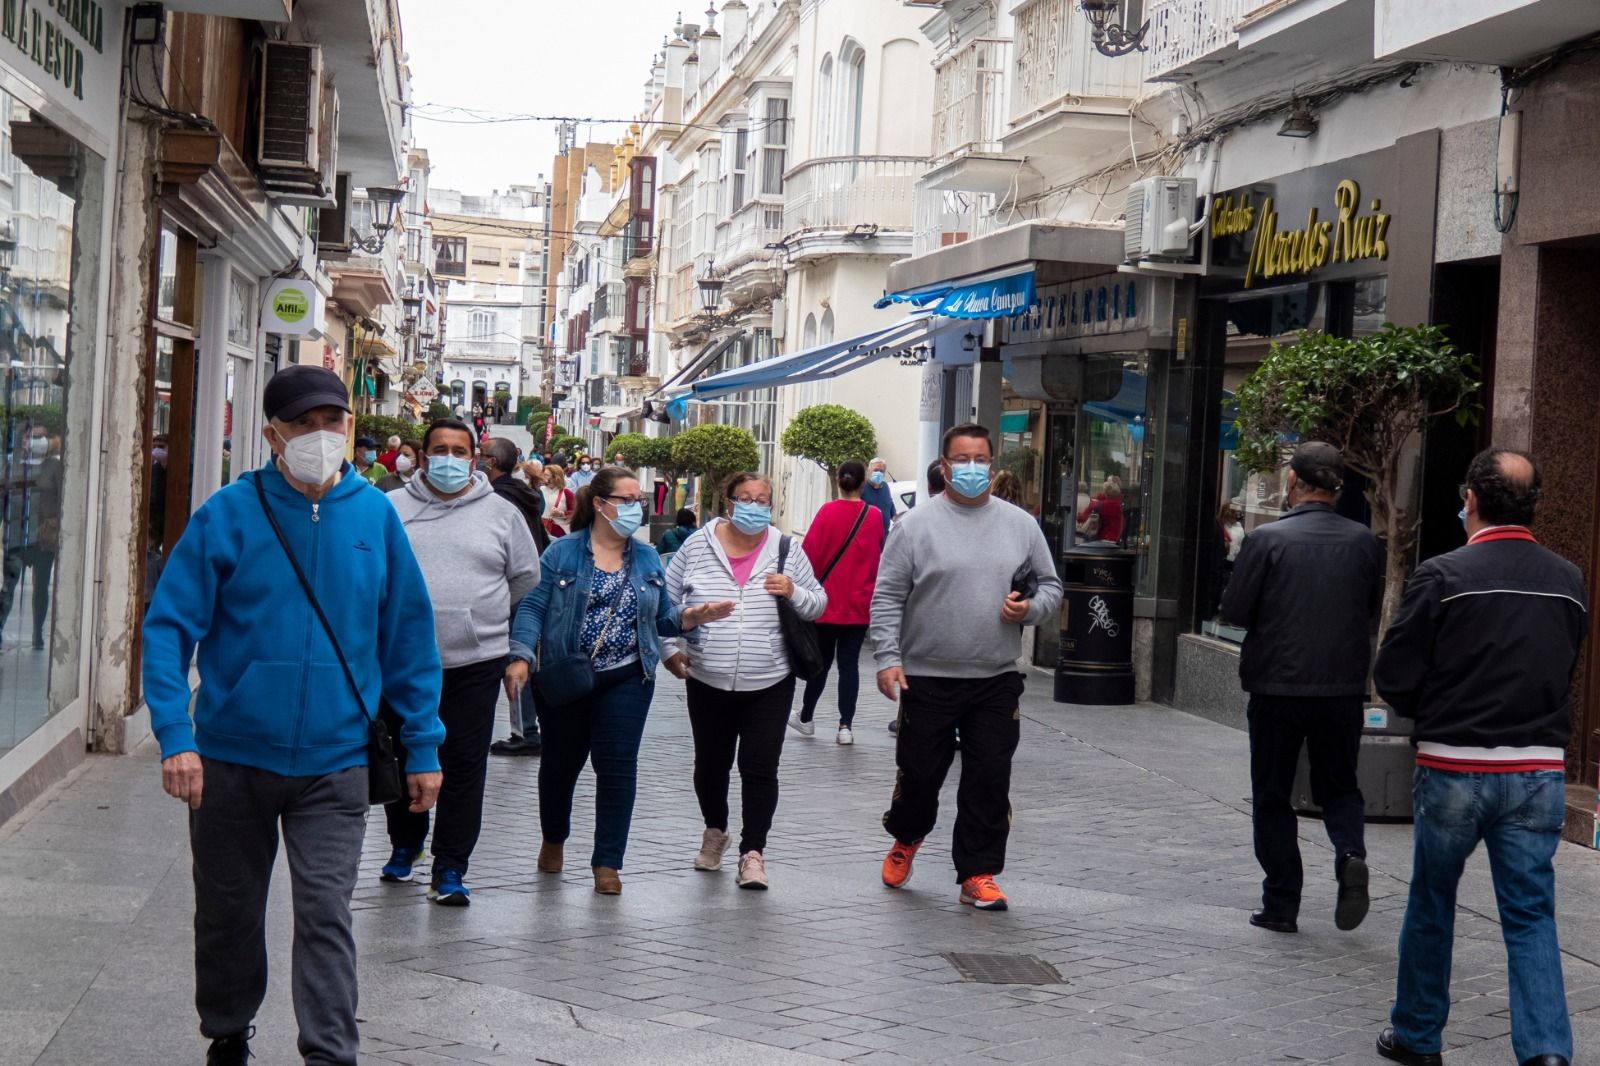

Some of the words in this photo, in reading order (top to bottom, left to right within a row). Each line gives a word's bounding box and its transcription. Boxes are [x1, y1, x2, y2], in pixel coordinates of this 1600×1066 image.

[1212, 192, 1254, 238] Calzados
[1244, 197, 1333, 288] Mercedes
[1332, 179, 1391, 263] Ruiz
